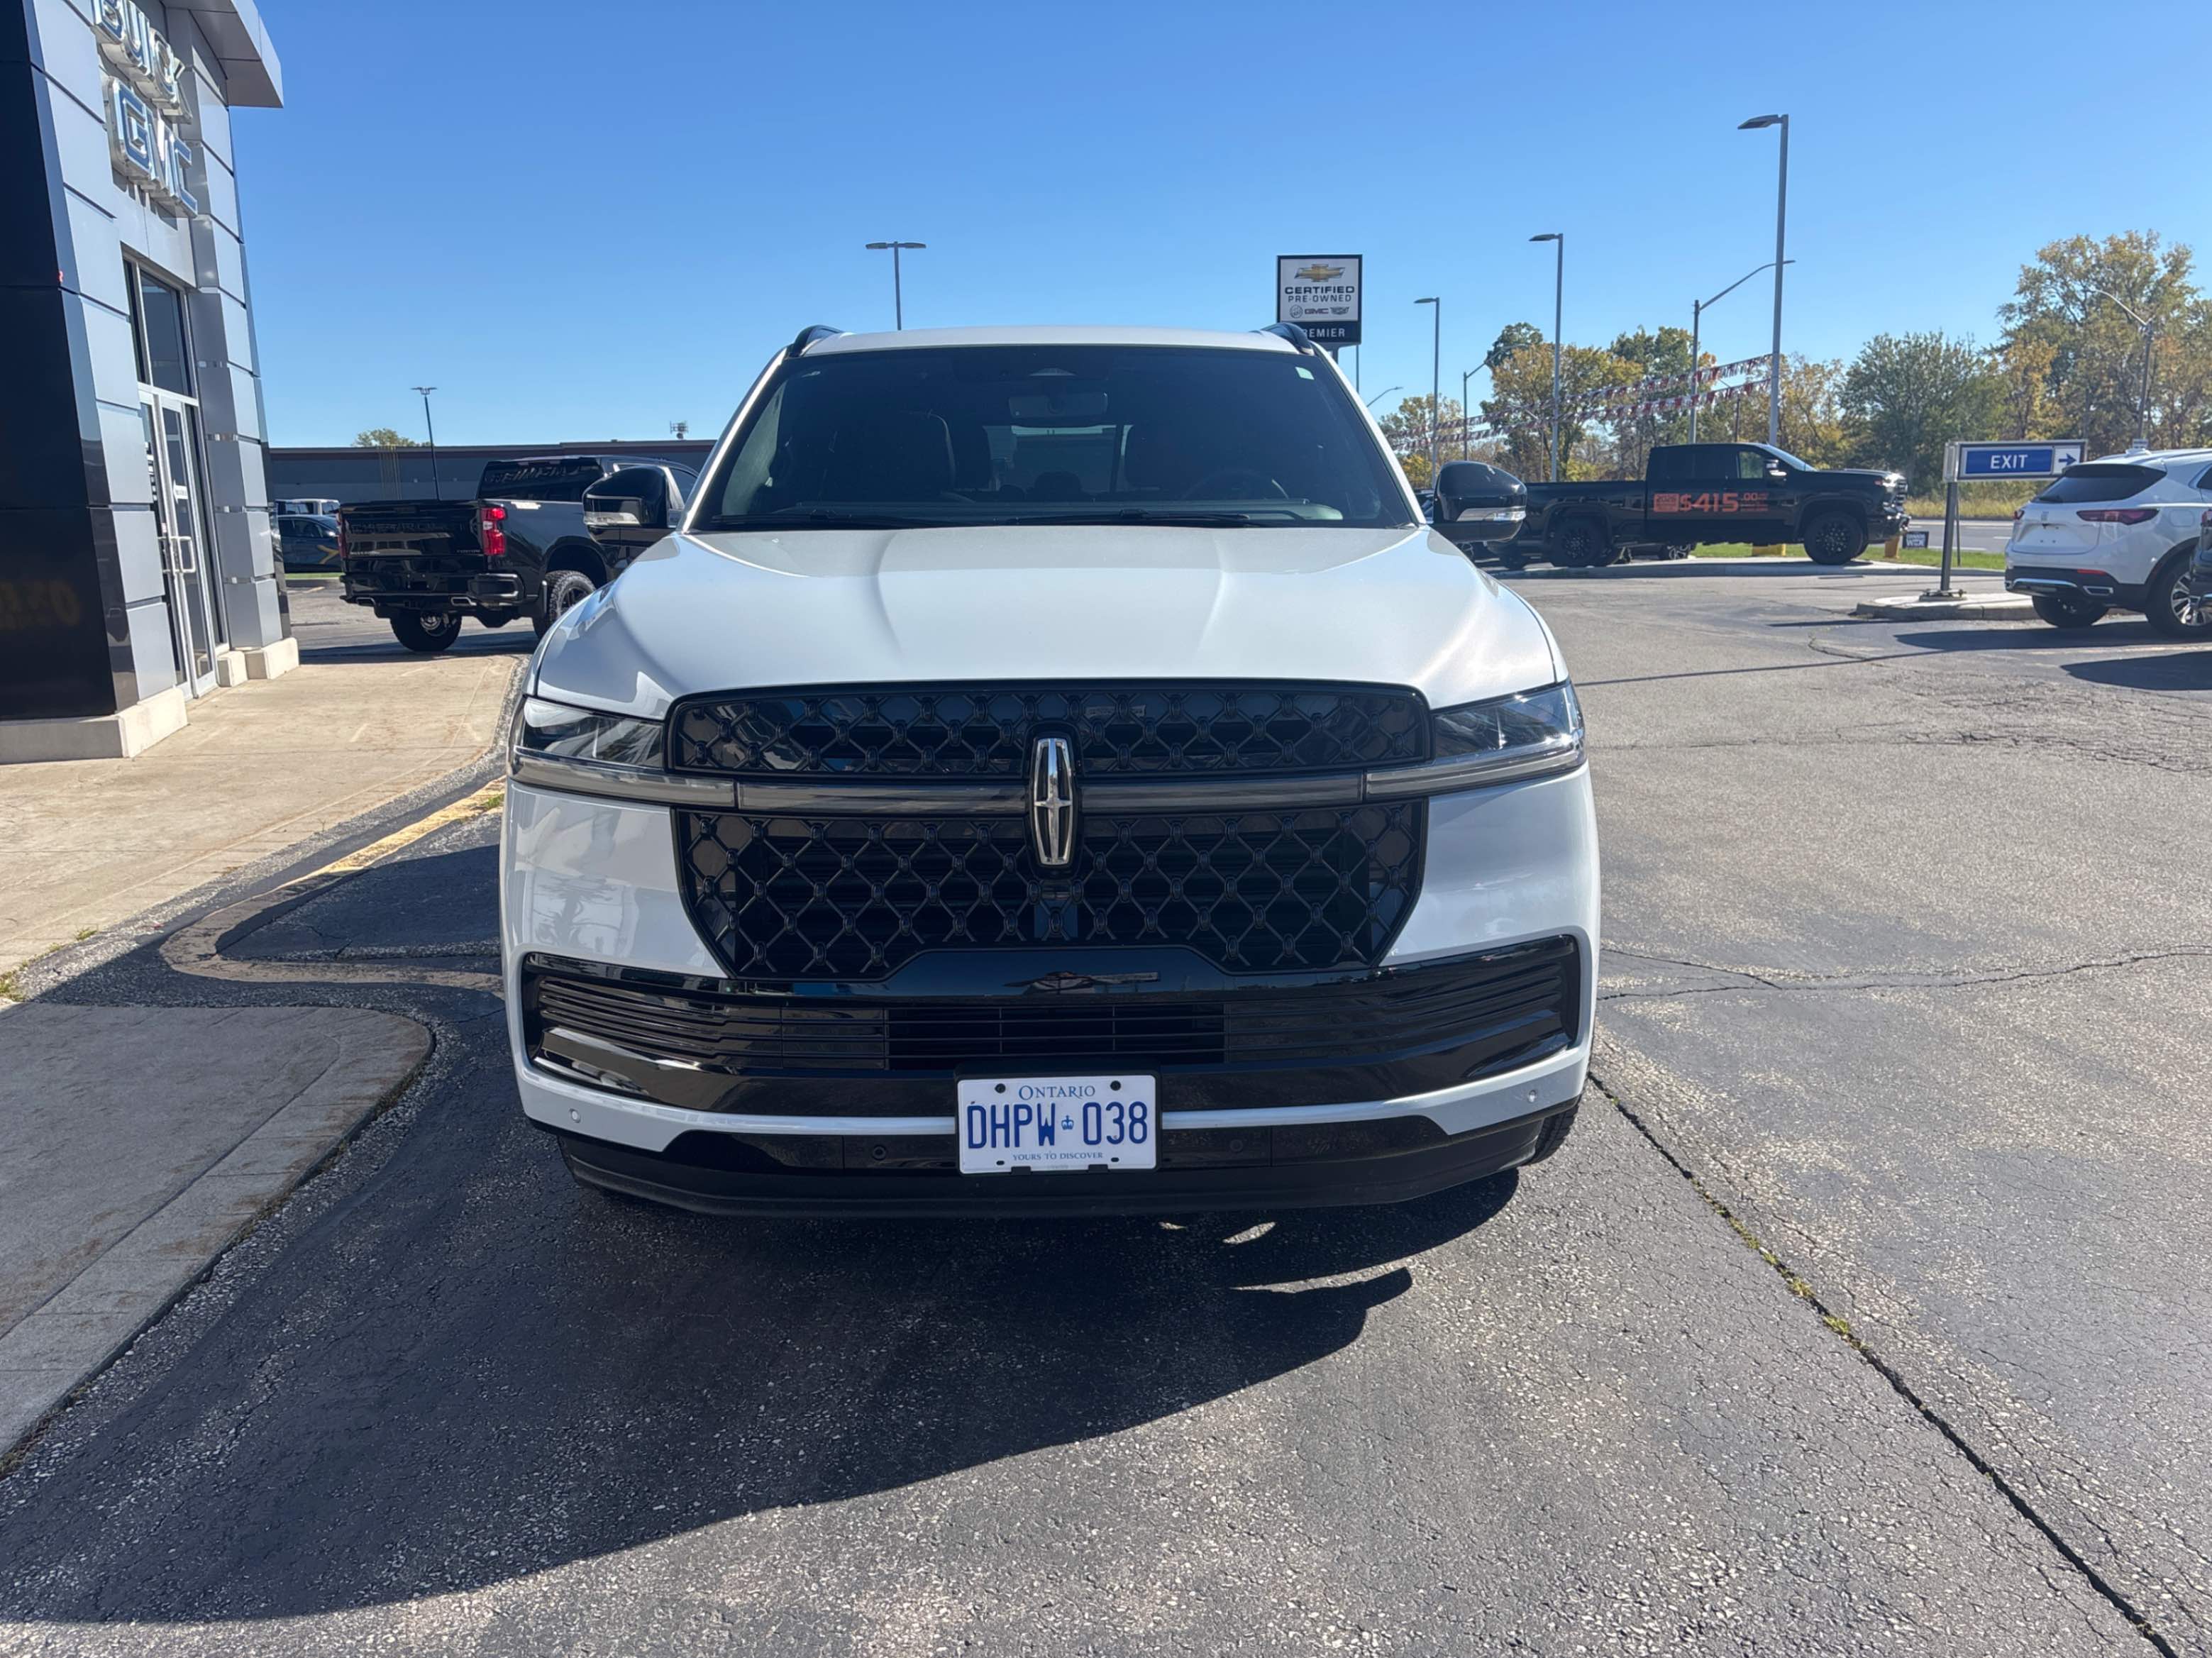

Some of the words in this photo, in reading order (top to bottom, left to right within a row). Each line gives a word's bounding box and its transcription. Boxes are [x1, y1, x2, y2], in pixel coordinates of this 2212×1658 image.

[1284, 286, 1355, 294] CERTIFIED
[1990, 454, 2028, 470] EXIT
[1019, 1085, 1095, 1100] ONTARIO
[967, 1102, 1056, 1149] DHPW
[1059, 1151, 1103, 1160] DISCOVER
